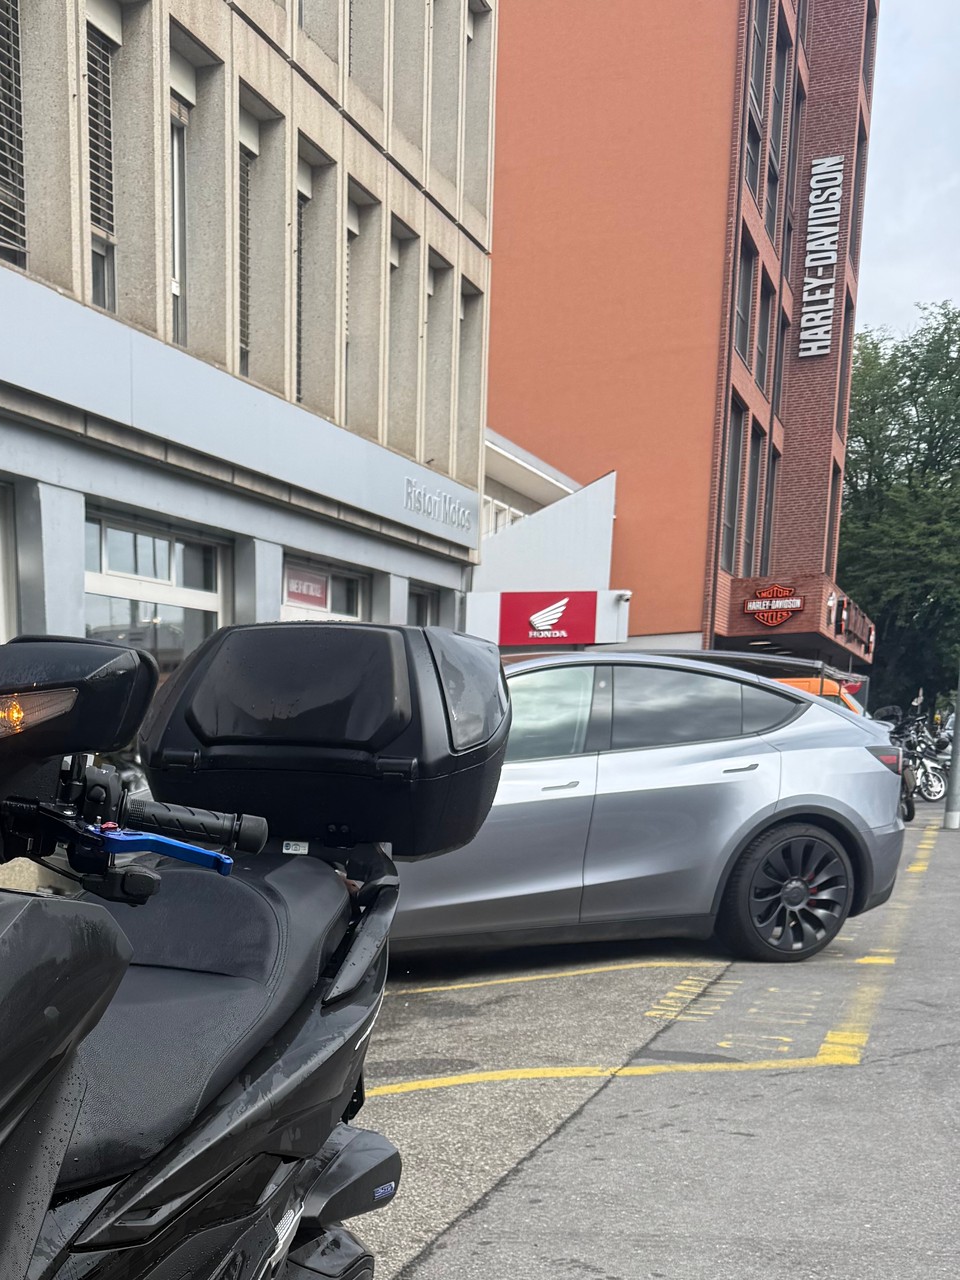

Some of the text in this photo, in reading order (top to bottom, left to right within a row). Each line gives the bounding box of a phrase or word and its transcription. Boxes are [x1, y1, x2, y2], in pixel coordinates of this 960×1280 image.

[798, 155, 844, 358] HARLEY-DAVIDSON
[760, 587, 790, 598] MOTOR
[747, 599, 801, 611] HARLEY-DAVIDSON
[528, 630, 568, 639] HONDA
